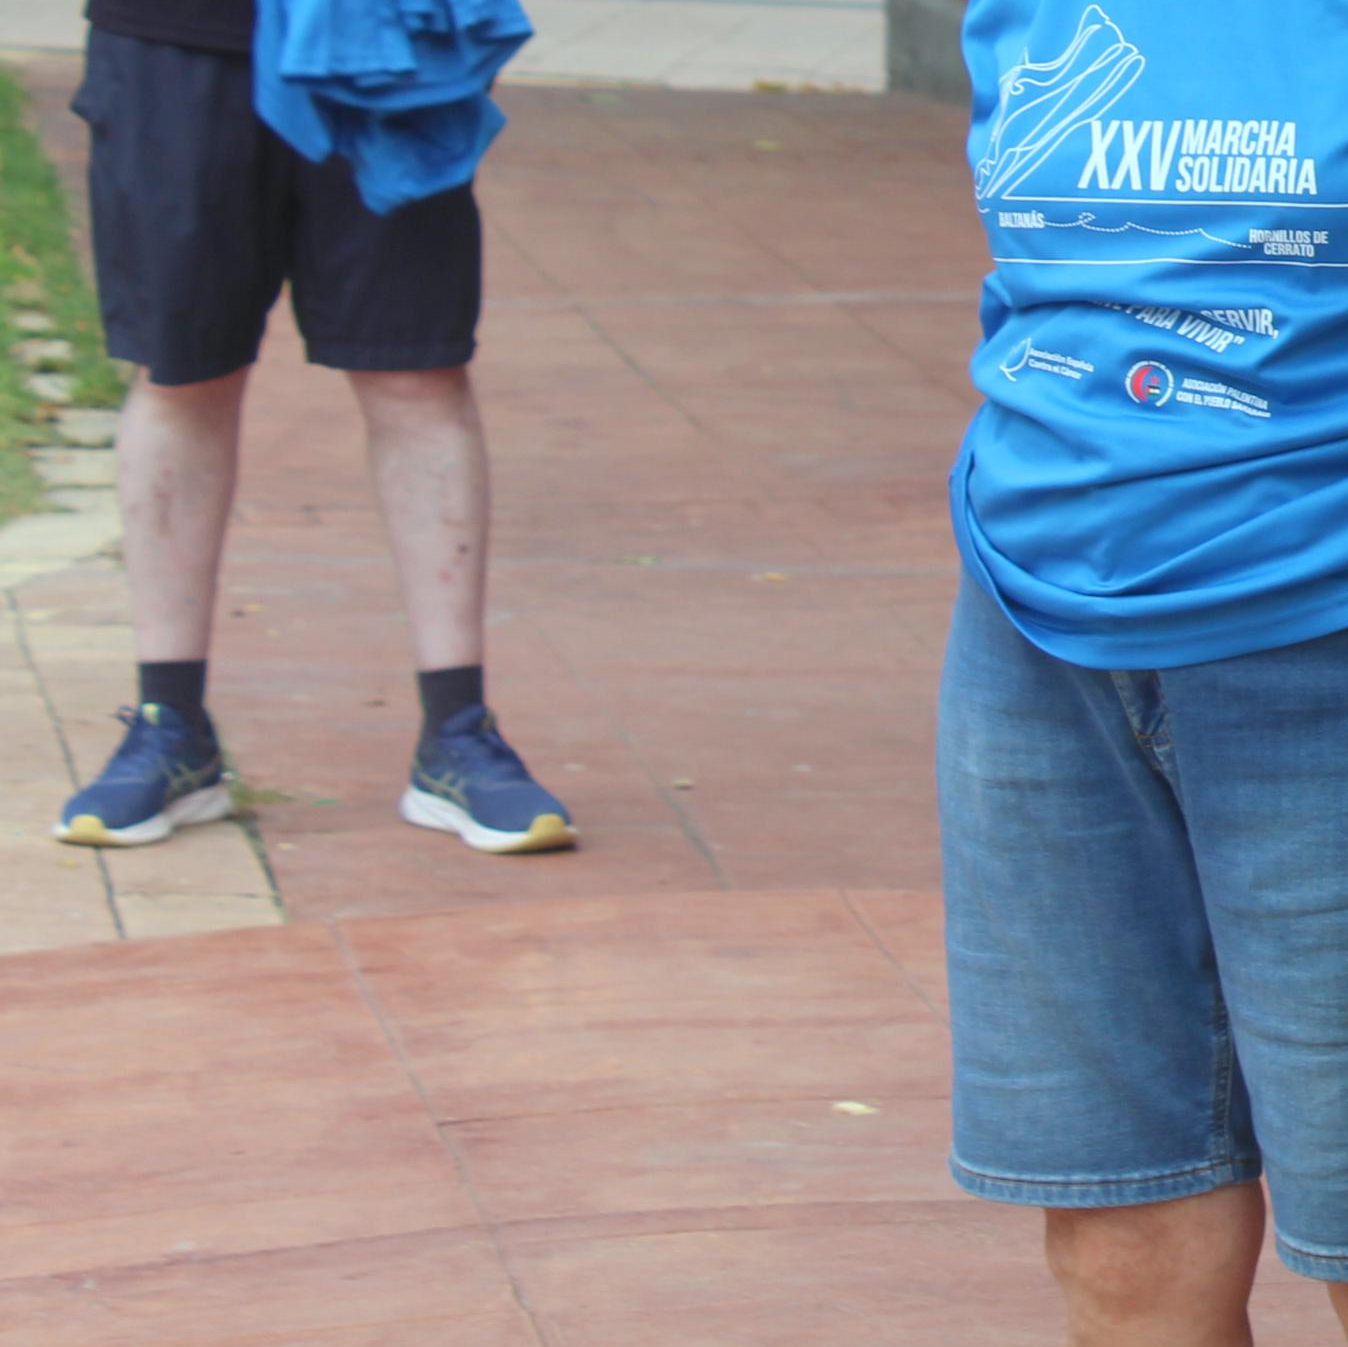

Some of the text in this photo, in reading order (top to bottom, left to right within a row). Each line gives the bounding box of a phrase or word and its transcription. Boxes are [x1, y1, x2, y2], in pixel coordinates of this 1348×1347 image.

[1077, 120, 1182, 191] XXV
[1180, 119, 1296, 156] MARCHA
[1175, 156, 1317, 195] SOLIDARIA
[1248, 228, 1329, 244] HORNILLOS DE
[1263, 244, 1315, 258] CERRATO
